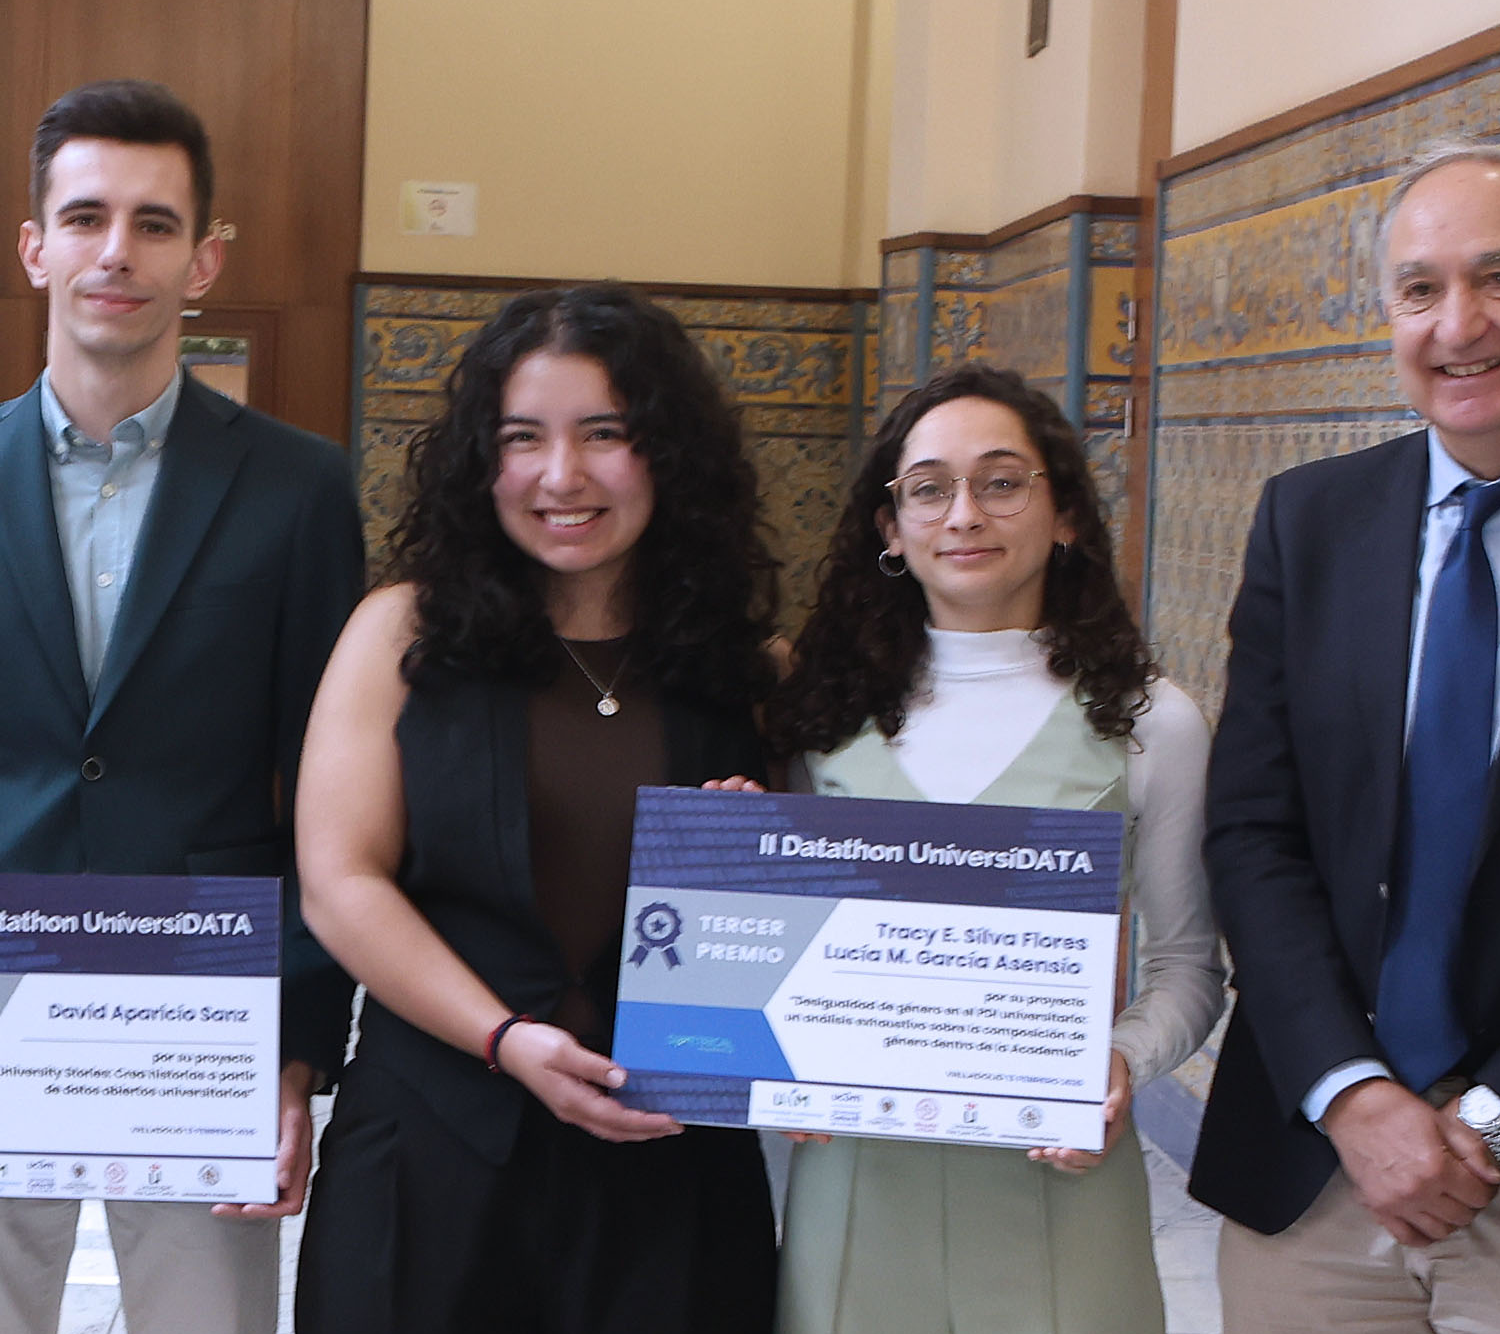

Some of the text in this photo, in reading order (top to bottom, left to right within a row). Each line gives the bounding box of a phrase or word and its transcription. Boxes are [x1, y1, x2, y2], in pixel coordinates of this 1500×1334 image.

[758, 832, 1094, 874] II Datathon UniversiDATA
[83, 909, 254, 936] UniversiDATA
[698, 915, 786, 936] TERCER
[876, 922, 1089, 951] Tracy E. Silva Flores
[695, 942, 785, 963] PREMIO
[824, 942, 1083, 975] Lucía M. García Asensio
[878, 1001, 894, 1012] de
[896, 1002, 942, 1016] género
[984, 992, 1007, 1004] por
[1027, 994, 1086, 1009] proyecto
[48, 1002, 250, 1026] David Aparicio Sanz
[802, 1012, 853, 1026] análisis
[855, 1017, 927, 1031] exhaustivo
[929, 1021, 965, 1033] sobre
[982, 1024, 1066, 1041] composición
[1067, 1029, 1086, 1042] de
[883, 1034, 928, 1048] género
[930, 1037, 974, 1051] dentro
[976, 1040, 993, 1052] de
[152, 1053, 175, 1065] por
[194, 1052, 256, 1066] proyecto
[147, 1068, 205, 1081] historias
[219, 1070, 257, 1083] partir
[43, 1084, 60, 1095] de
[62, 1084, 100, 1096] datos
[101, 1085, 157, 1097] abiertos
